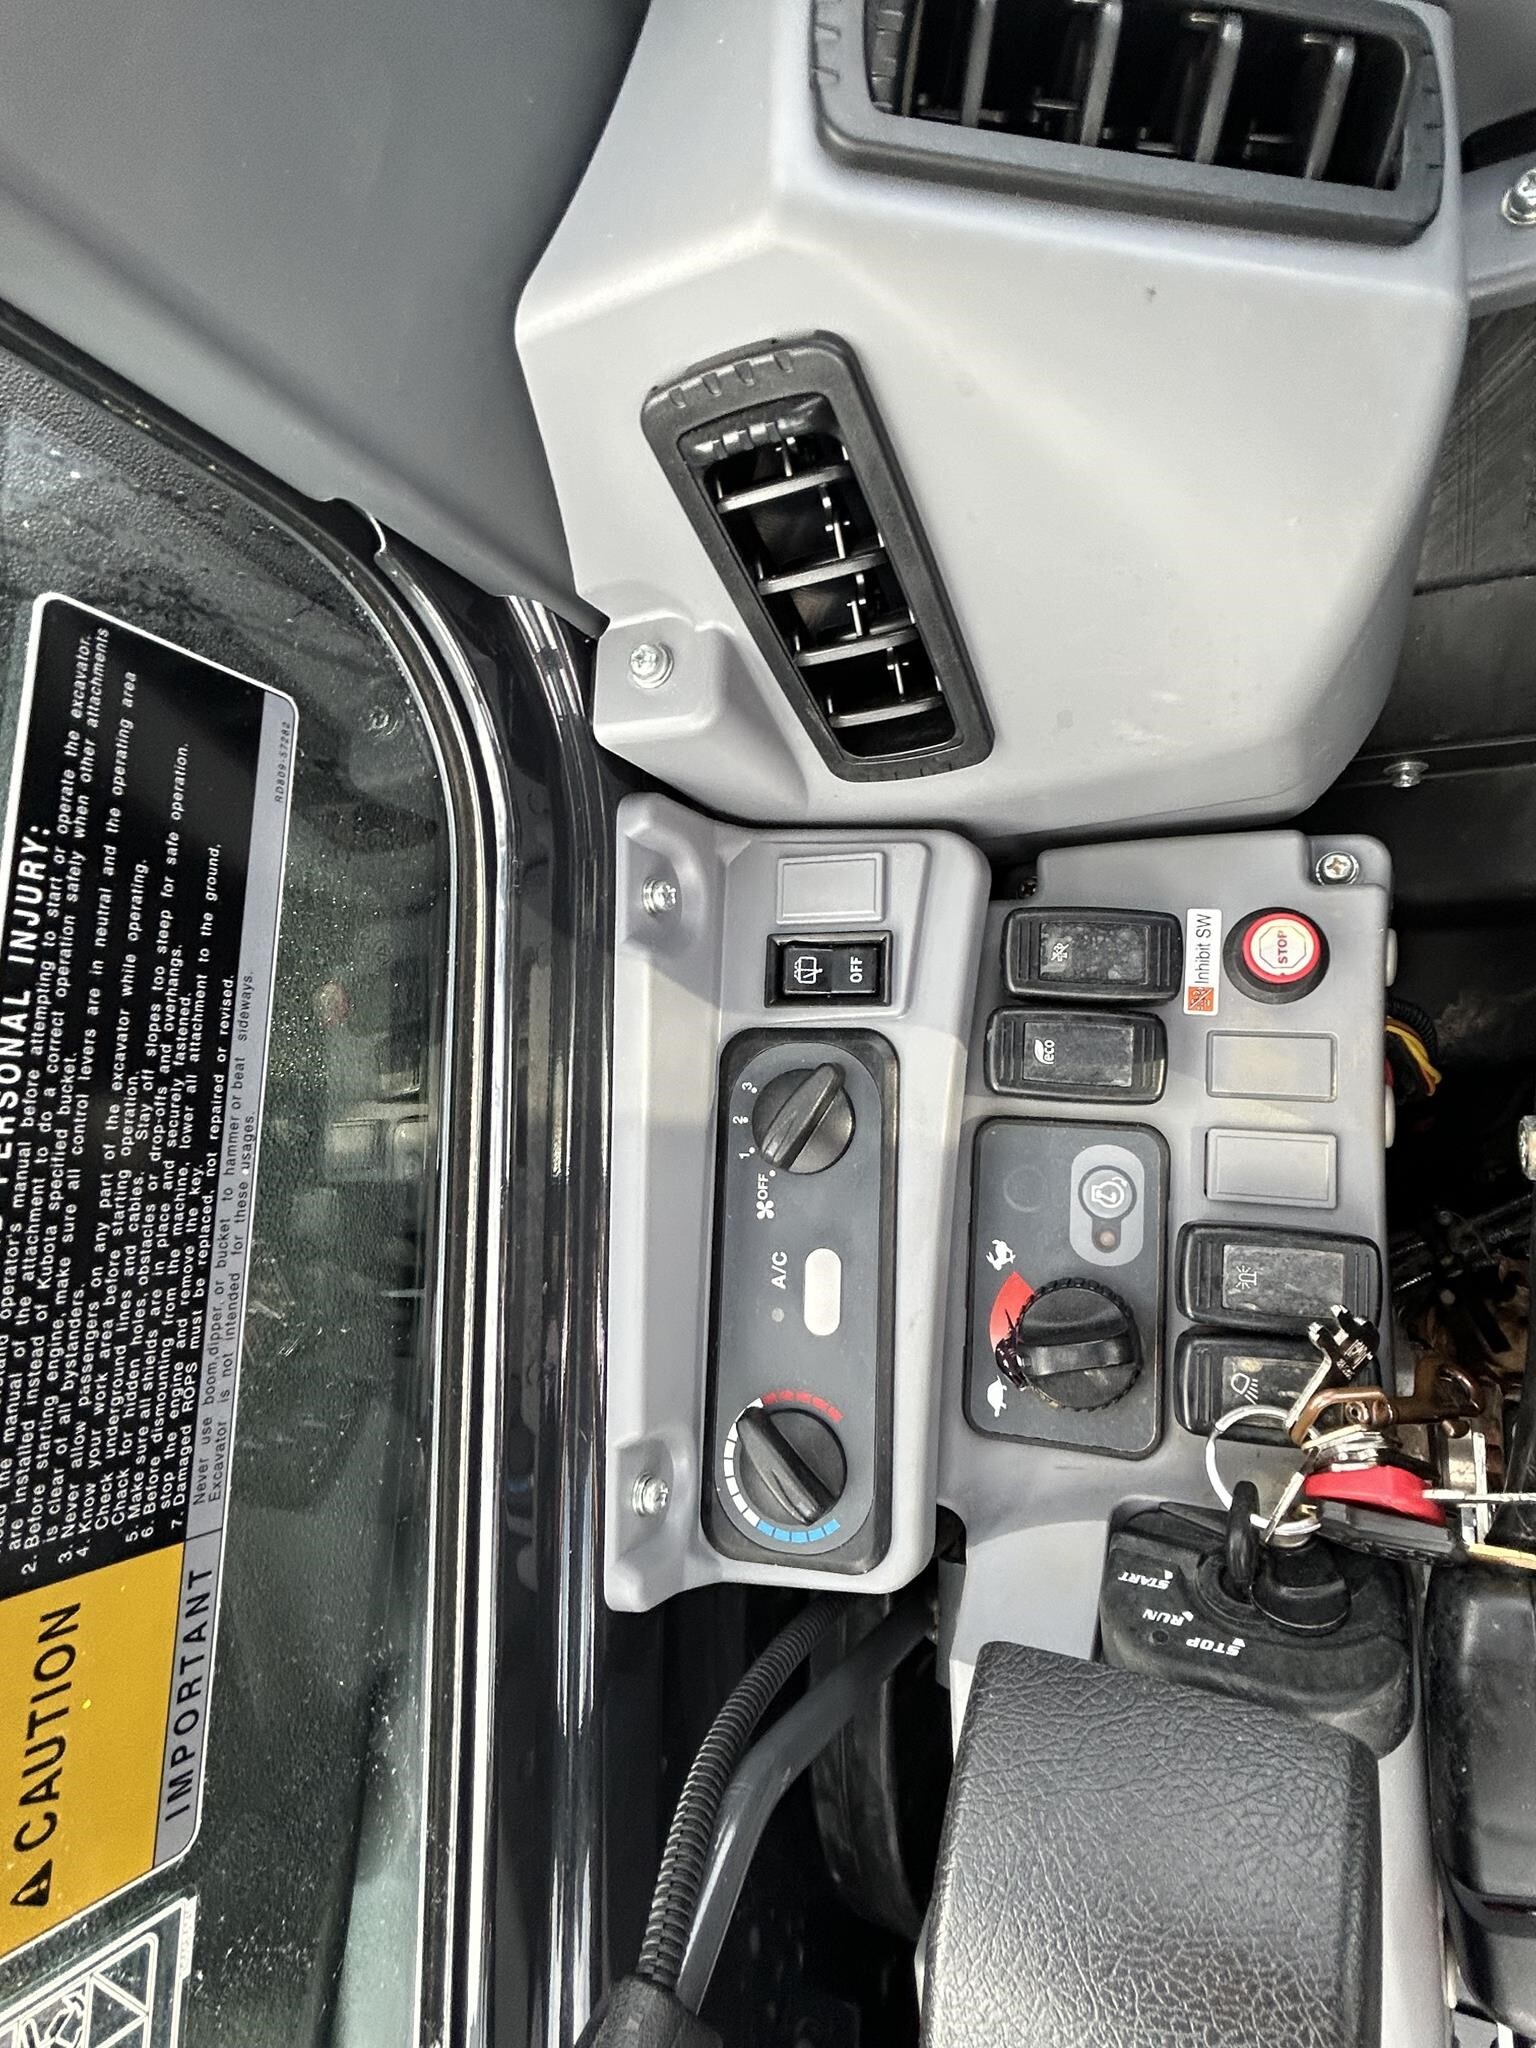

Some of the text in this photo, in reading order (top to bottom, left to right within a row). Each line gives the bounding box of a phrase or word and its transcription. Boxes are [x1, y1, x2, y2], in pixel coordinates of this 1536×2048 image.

[70, 636, 92, 719] excavator.
[86, 628, 110, 728] attachments
[63, 730, 81, 757] the
[79, 738, 96, 783] other
[56, 769, 76, 835] operate
[71, 795, 90, 838] when
[53, 846, 66, 865] or
[65, 850, 87, 903] safely
[7, 825, 51, 965] INJURY:
[46, 876, 63, 918] start
[41, 930, 57, 947] to
[199, 912, 214, 936] the
[55, 915, 76, 998] operation
[197, 948, 210, 963] to
[1194, 913, 1212, 984] Inhibit SW
[1277, 930, 1288, 964] STOP
[163, 944, 184, 1032] overhangs.
[850, 956, 863, 983] OFF
[29, 960, 57, 1056] attempting
[188, 974, 208, 1063] attachment
[236, 972, 256, 1042] sideways.
[46, 1011, 65, 1074] correct
[159, 1043, 173, 1074] and
[1043, 1039, 1056, 1062] eco
[43, 1087, 57, 1098] a
[184, 1074, 198, 1094] all
[229, 1057, 246, 1090] beat
[741, 1081, 753, 1091] 3
[19, 1069, 41, 1128] before
[230, 1094, 242, 1110] or
[733, 1115, 744, 1125] 2
[20, 671, 137, 1575] 2. Before starting engine, make sure all control levers are in neutral and the operating area
[37, 1110, 53, 1133] do
[94, 743, 189, 1531] Check underground lines and cables. Stay off slopes too steep for safe operation.
[148, 1086, 168, 1162] drop-offs
[178, 1105, 194, 1149] lower
[33, 1146, 49, 1164] to
[224, 1115, 241, 1176] hammer
[739, 1151, 750, 1160] 1
[12, 1141, 32, 1208] manual
[147, 1174, 159, 1191] or
[219, 1187, 234, 1202] to
[757, 1173, 769, 1200] OFF
[57, 860, 149, 1564] 3. Never allow passengers on any part of the excavator while operating.
[172, 1162, 191, 1236] machine,
[21, 1178, 46, 1282] attachment
[136, 1203, 156, 1286] obstacles
[170, 975, 234, 1529] 7. Damaged ROPS must be replaced, not repaired or revised.
[213, 1218, 231, 1269] bucket
[0, 1222, 23, 1320] operator's
[124, 993, 192, 1543] 5. Make sure all shields are in place and securely fastened.
[166, 1248, 181, 1275] the
[770, 1251, 788, 1290] A/C
[8, 1052, 77, 1551] are installed instead of Kubota specified bucket.
[161, 1287, 177, 1326] from
[212, 1280, 225, 1296] or
[14, 1296, 32, 1326] the
[75, 1071, 140, 1557] 4. Know your work area before starting operation.
[129, 1292, 149, 1346] holes,
[11, 1340, 27, 1358] of
[2, 1372, 23, 1444] manual
[122, 1358, 141, 1419] hidden
[150, 1337, 175, 1444] dismounting
[118, 1431, 134, 1456] for
[201, 1417, 213, 1445] use
[0, 1458, 13, 1489] the
[142, 1456, 161, 1515] Before
[191, 1458, 210, 1506] Never
[140, 1520, 154, 1538] 6.
[1118, 1571, 1171, 1590] START
[1142, 1608, 1185, 1627] RUN
[1186, 1637, 1241, 1657] STOP
[164, 1570, 212, 1822] IMPORTANT
[13, 1603, 81, 1852] CAUTION
